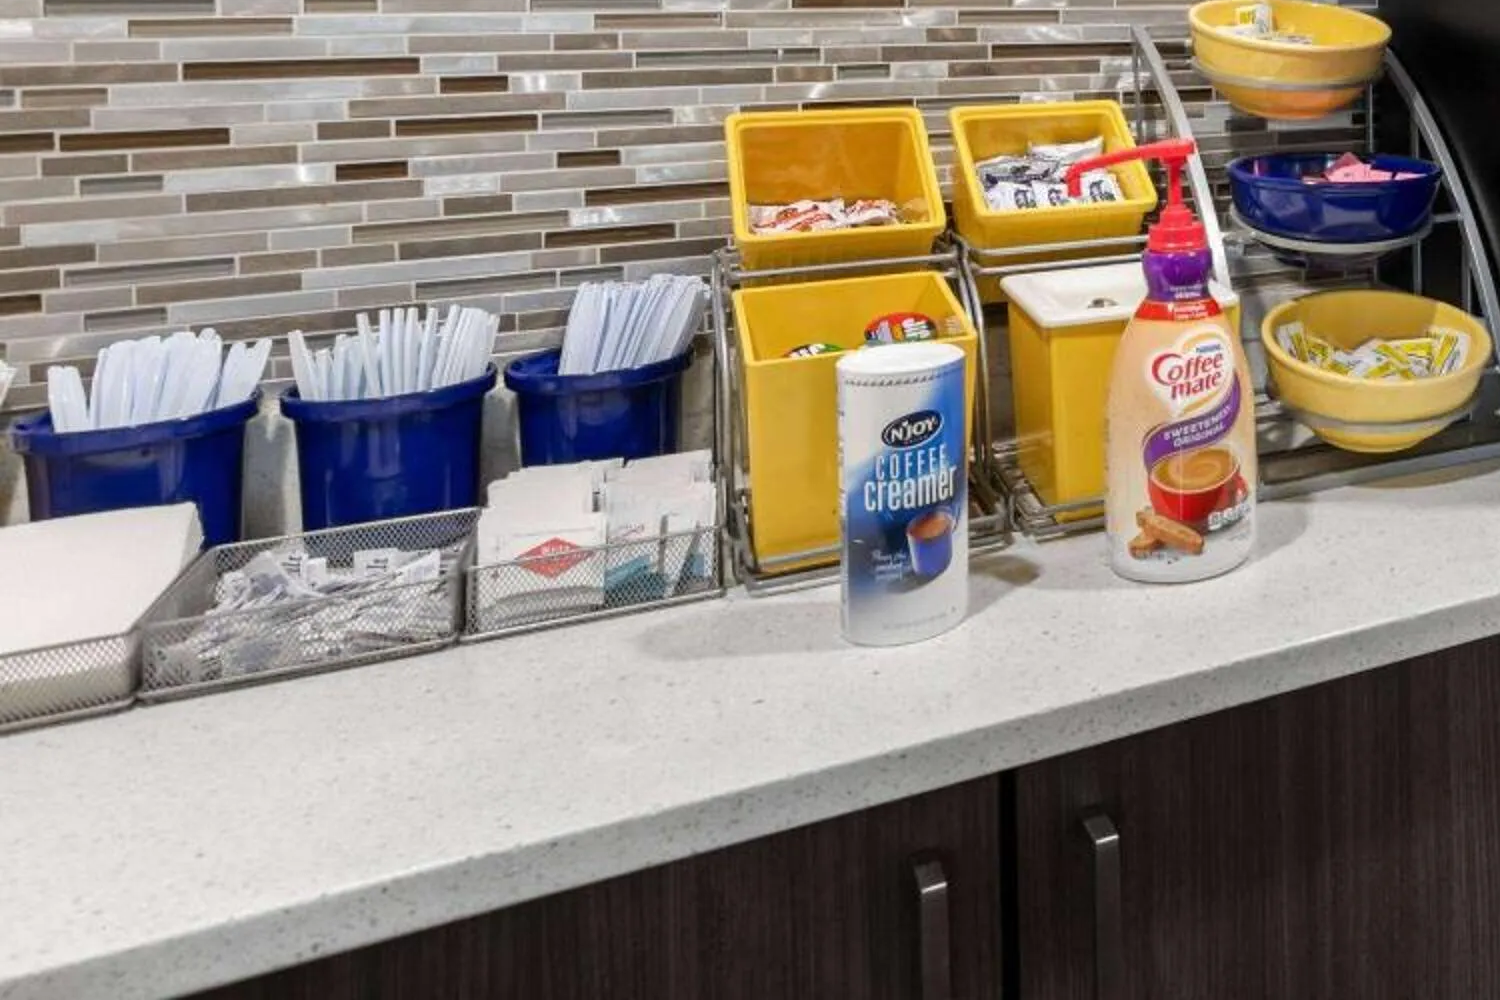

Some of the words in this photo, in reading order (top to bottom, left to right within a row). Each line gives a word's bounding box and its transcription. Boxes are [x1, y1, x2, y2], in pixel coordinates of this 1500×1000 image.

[1151, 352, 1223, 386] Coffee
[1171, 371, 1221, 400] mate
[875, 443, 947, 480] COFFEE
[864, 465, 957, 512] creamer
